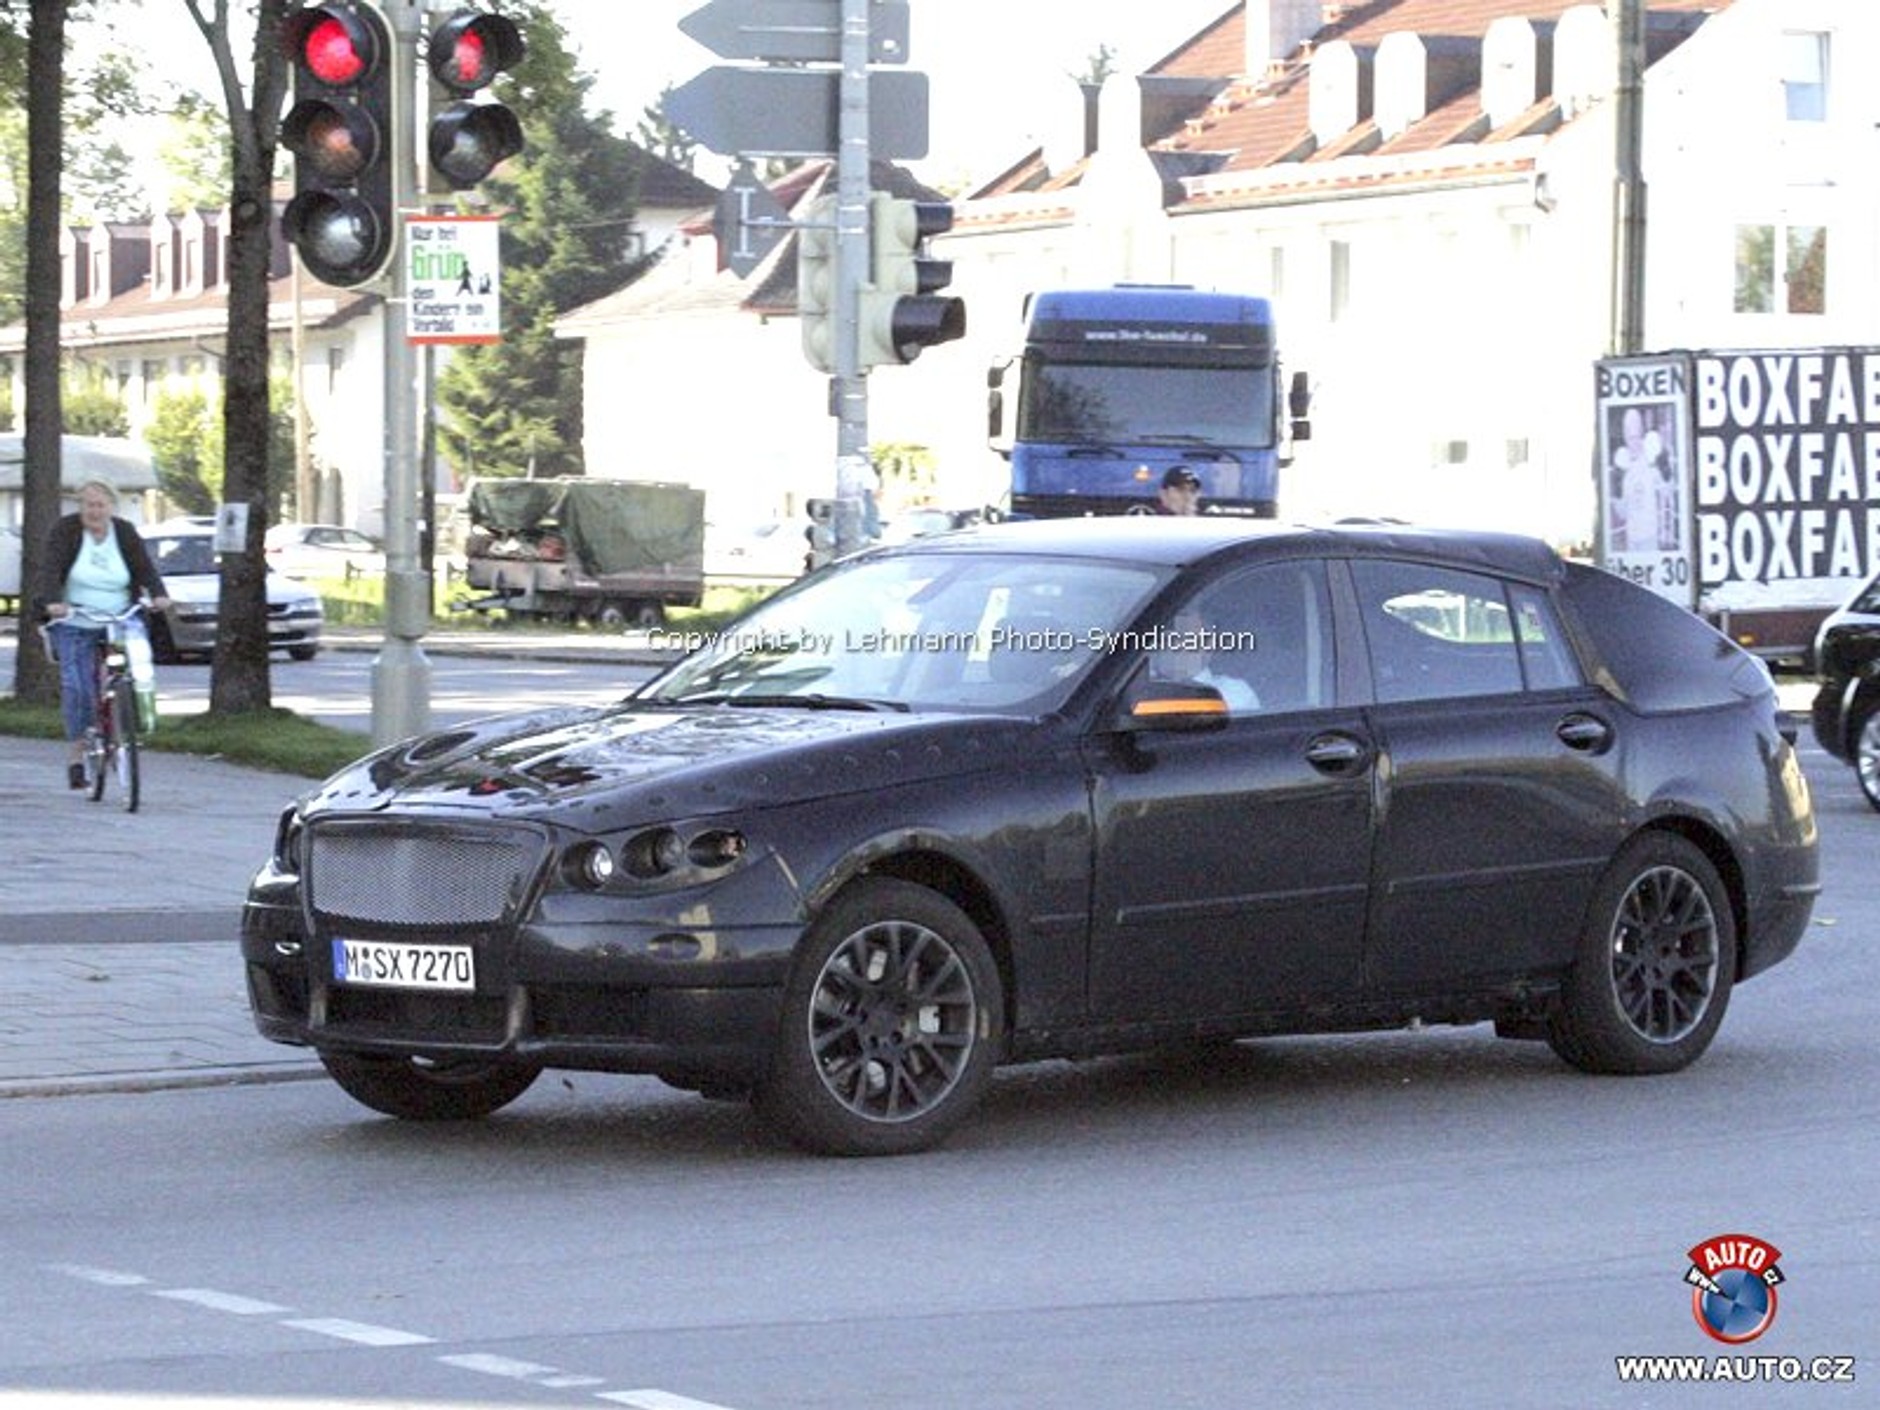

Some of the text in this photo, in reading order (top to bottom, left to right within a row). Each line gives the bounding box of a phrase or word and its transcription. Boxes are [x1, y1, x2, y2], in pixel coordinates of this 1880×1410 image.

[1598, 366, 1686, 398] BOXEN
[1661, 556, 1689, 586] 30
[346, 946, 359, 977] M
[408, 950, 470, 982] 7270
